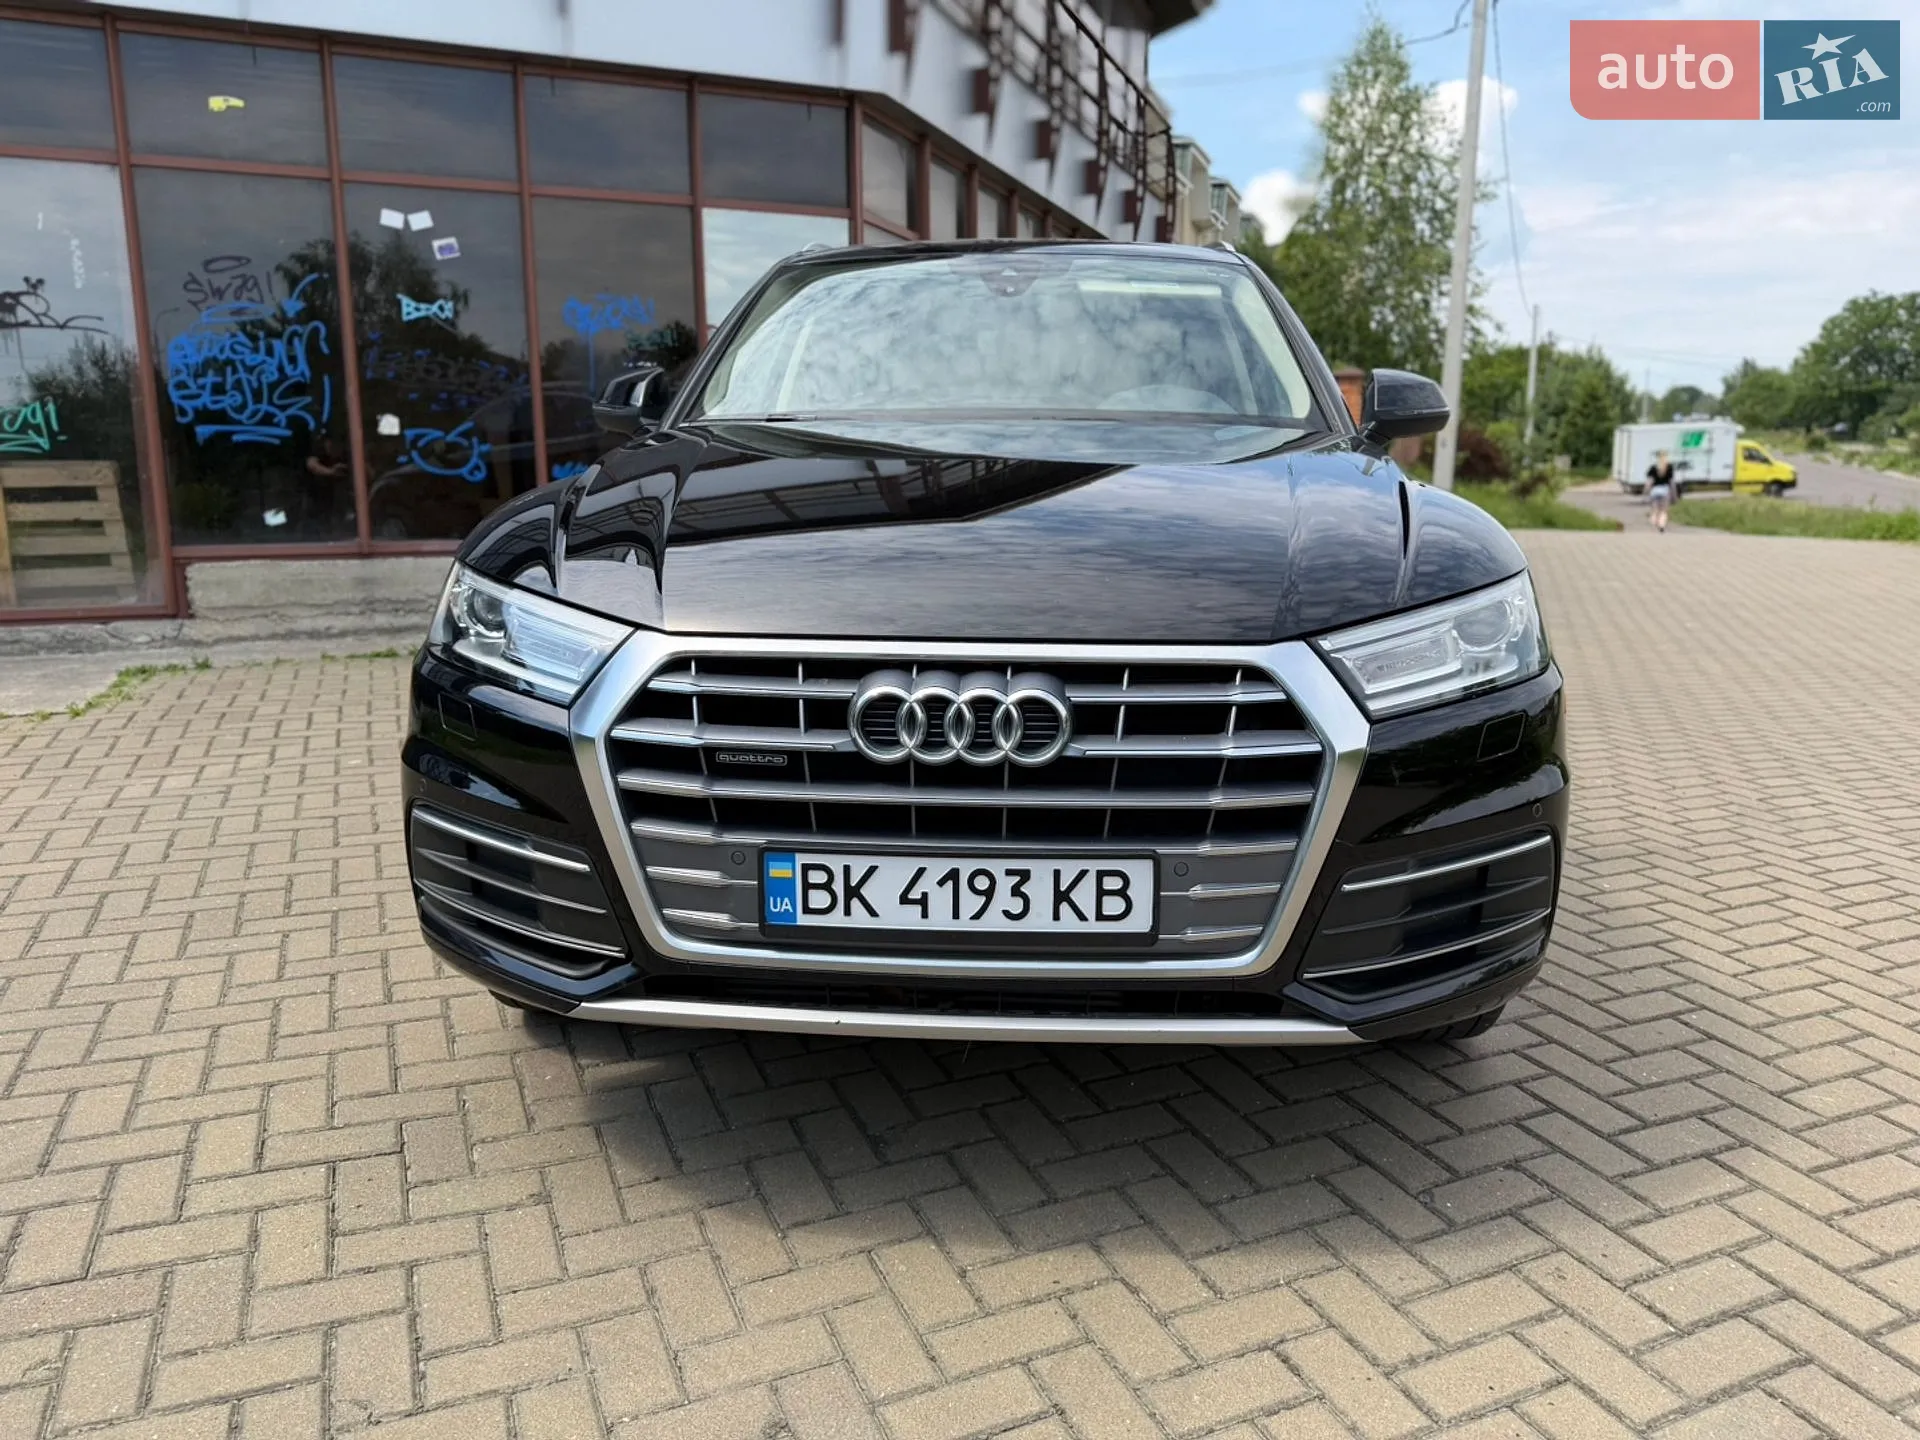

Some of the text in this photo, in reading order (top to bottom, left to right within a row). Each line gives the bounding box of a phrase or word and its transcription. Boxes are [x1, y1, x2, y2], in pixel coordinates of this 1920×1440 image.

[718, 754, 784, 764] quattro
[801, 862, 1133, 922] BK 4193 KB
[769, 896, 793, 913] UA
